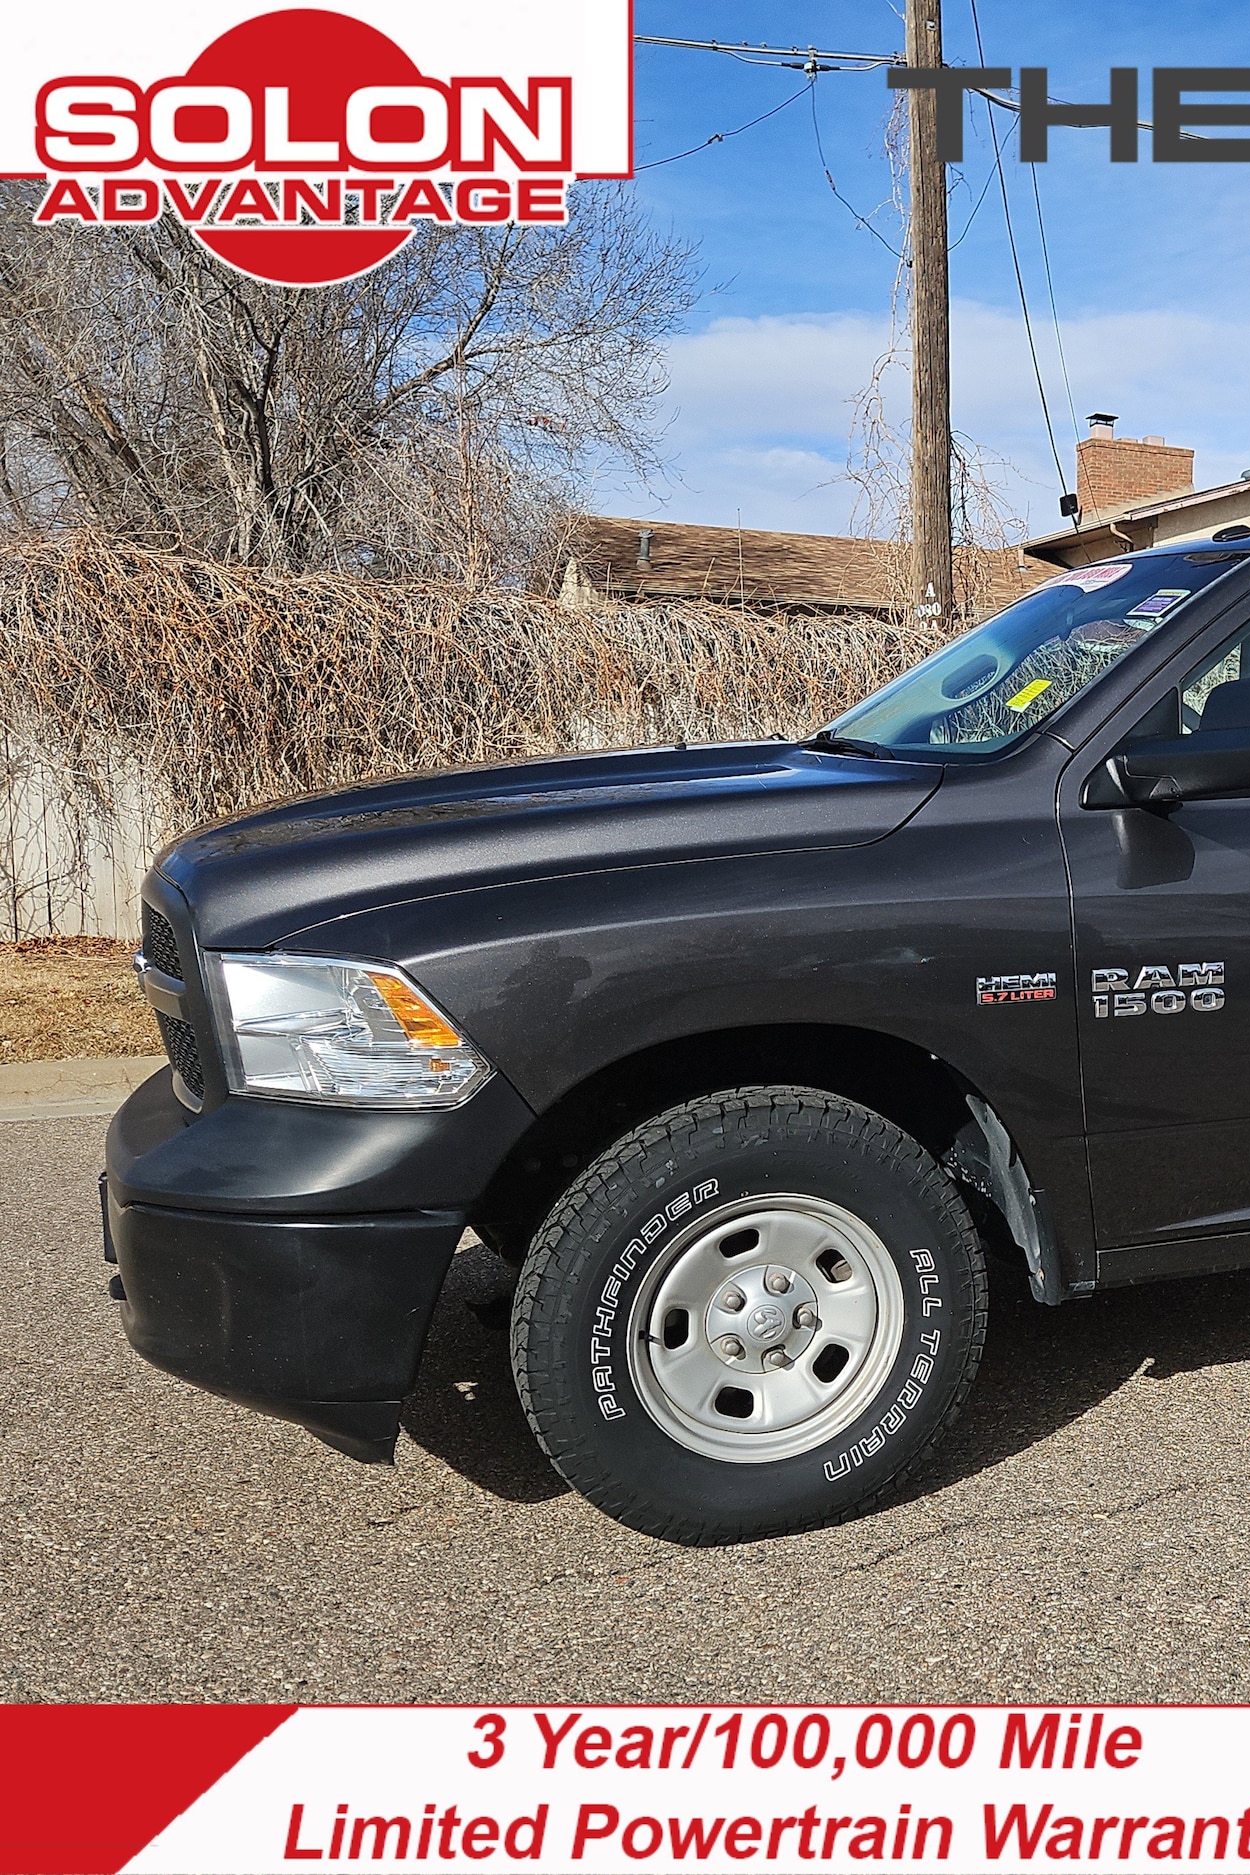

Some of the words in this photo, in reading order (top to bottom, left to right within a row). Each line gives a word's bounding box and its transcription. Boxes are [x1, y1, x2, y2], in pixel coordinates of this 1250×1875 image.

[976, 972, 1057, 993] HEMI
[1092, 961, 1225, 992] RAM
[981, 992, 1008, 1003] 5.7
[1010, 989, 1055, 1001] LITER
[1092, 987, 1225, 1018] 1500
[909, 1247, 943, 1318] ALL
[590, 1178, 720, 1422] PATHFINDER
[823, 1328, 942, 1483] TERRAIN
